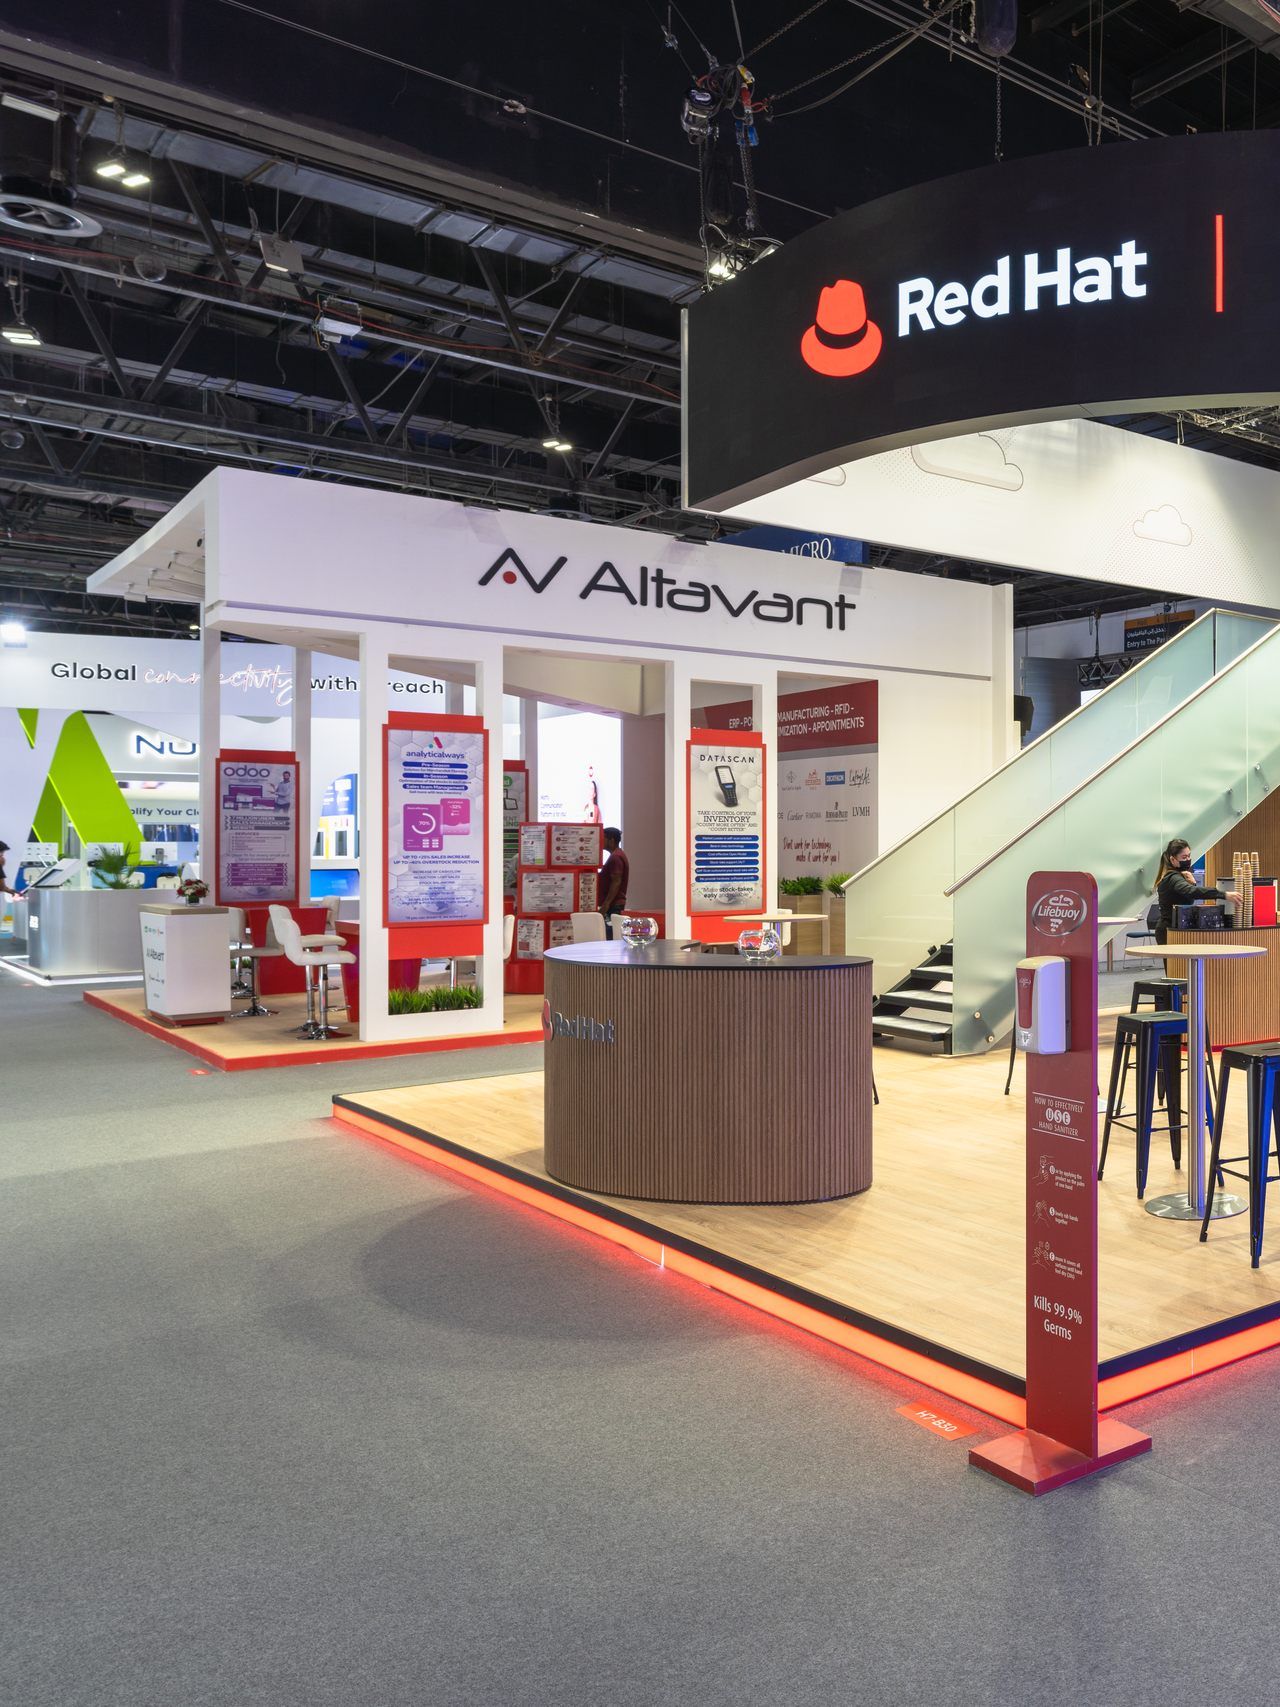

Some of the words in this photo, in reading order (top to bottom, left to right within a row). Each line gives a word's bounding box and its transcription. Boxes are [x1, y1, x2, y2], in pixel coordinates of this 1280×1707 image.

[897, 255, 1010, 337] Red
[1024, 240, 1148, 311] Hat
[579, 561, 856, 631] Altavant
[1127, 640, 1140, 648] Entry
[50, 662, 136, 682] Global
[311, 675, 357, 691] with
[387, 680, 444, 694] each
[778, 705, 830, 722] MANUFACTURING
[834, 703, 850, 715] RFID
[729, 718, 740, 729] ERP
[812, 717, 865, 732] APPOINTMENTS
[406, 750, 465, 759] analyticalways
[700, 754, 755, 763] DATASCAN
[223, 765, 270, 778] odoo
[156, 808, 182, 816] Your
[703, 815, 751, 823] INVENTORY
[852, 806, 870, 817] LVMH
[1038, 905, 1080, 921] Lifebuoy
[1035, 1096, 1046, 1106] HOW
[1047, 1099, 1054, 1107] TO
[1054, 1100, 1084, 1113] EFFECTIVELY
[1046, 1108, 1070, 1125] USE
[1038, 1120, 1053, 1130] HAND
[1054, 1124, 1079, 1136] SANITIZER
[1034, 1295, 1052, 1313] Kills
[1054, 1302, 1083, 1325] 99.9%
[1043, 1319, 1072, 1341] Germs
[915, 1410, 957, 1432] H7-B30
